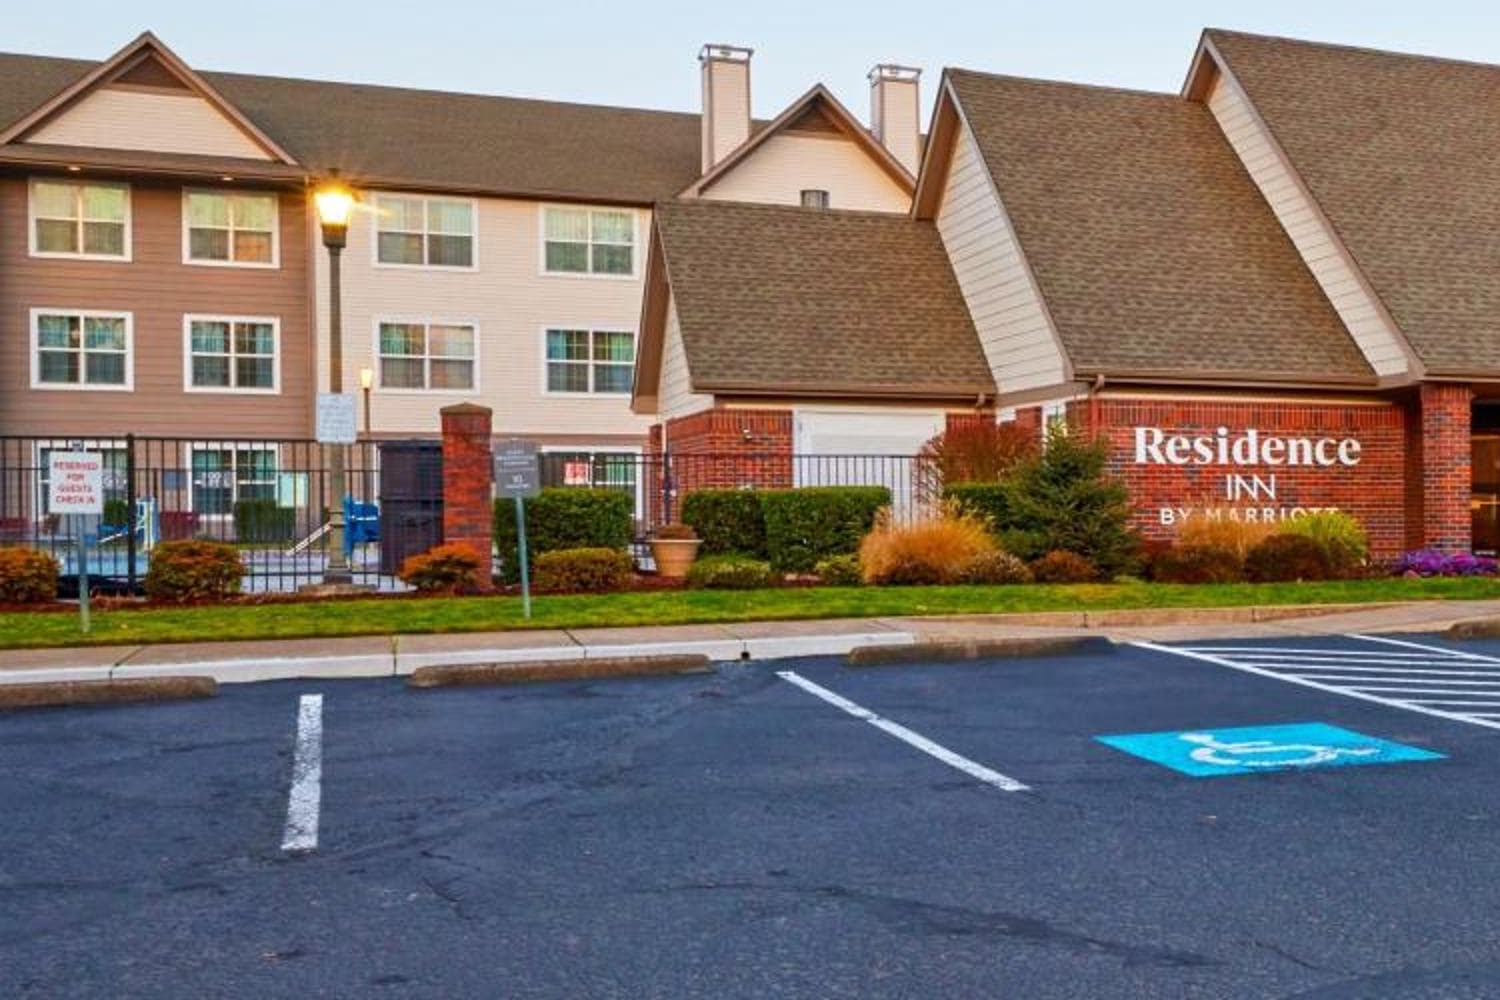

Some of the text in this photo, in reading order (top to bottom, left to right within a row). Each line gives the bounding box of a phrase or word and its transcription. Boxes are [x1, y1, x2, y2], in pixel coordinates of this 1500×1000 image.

[1134, 426, 1361, 465] Residence
[1226, 474, 1276, 500] INN
[1160, 507, 1193, 525] BY
